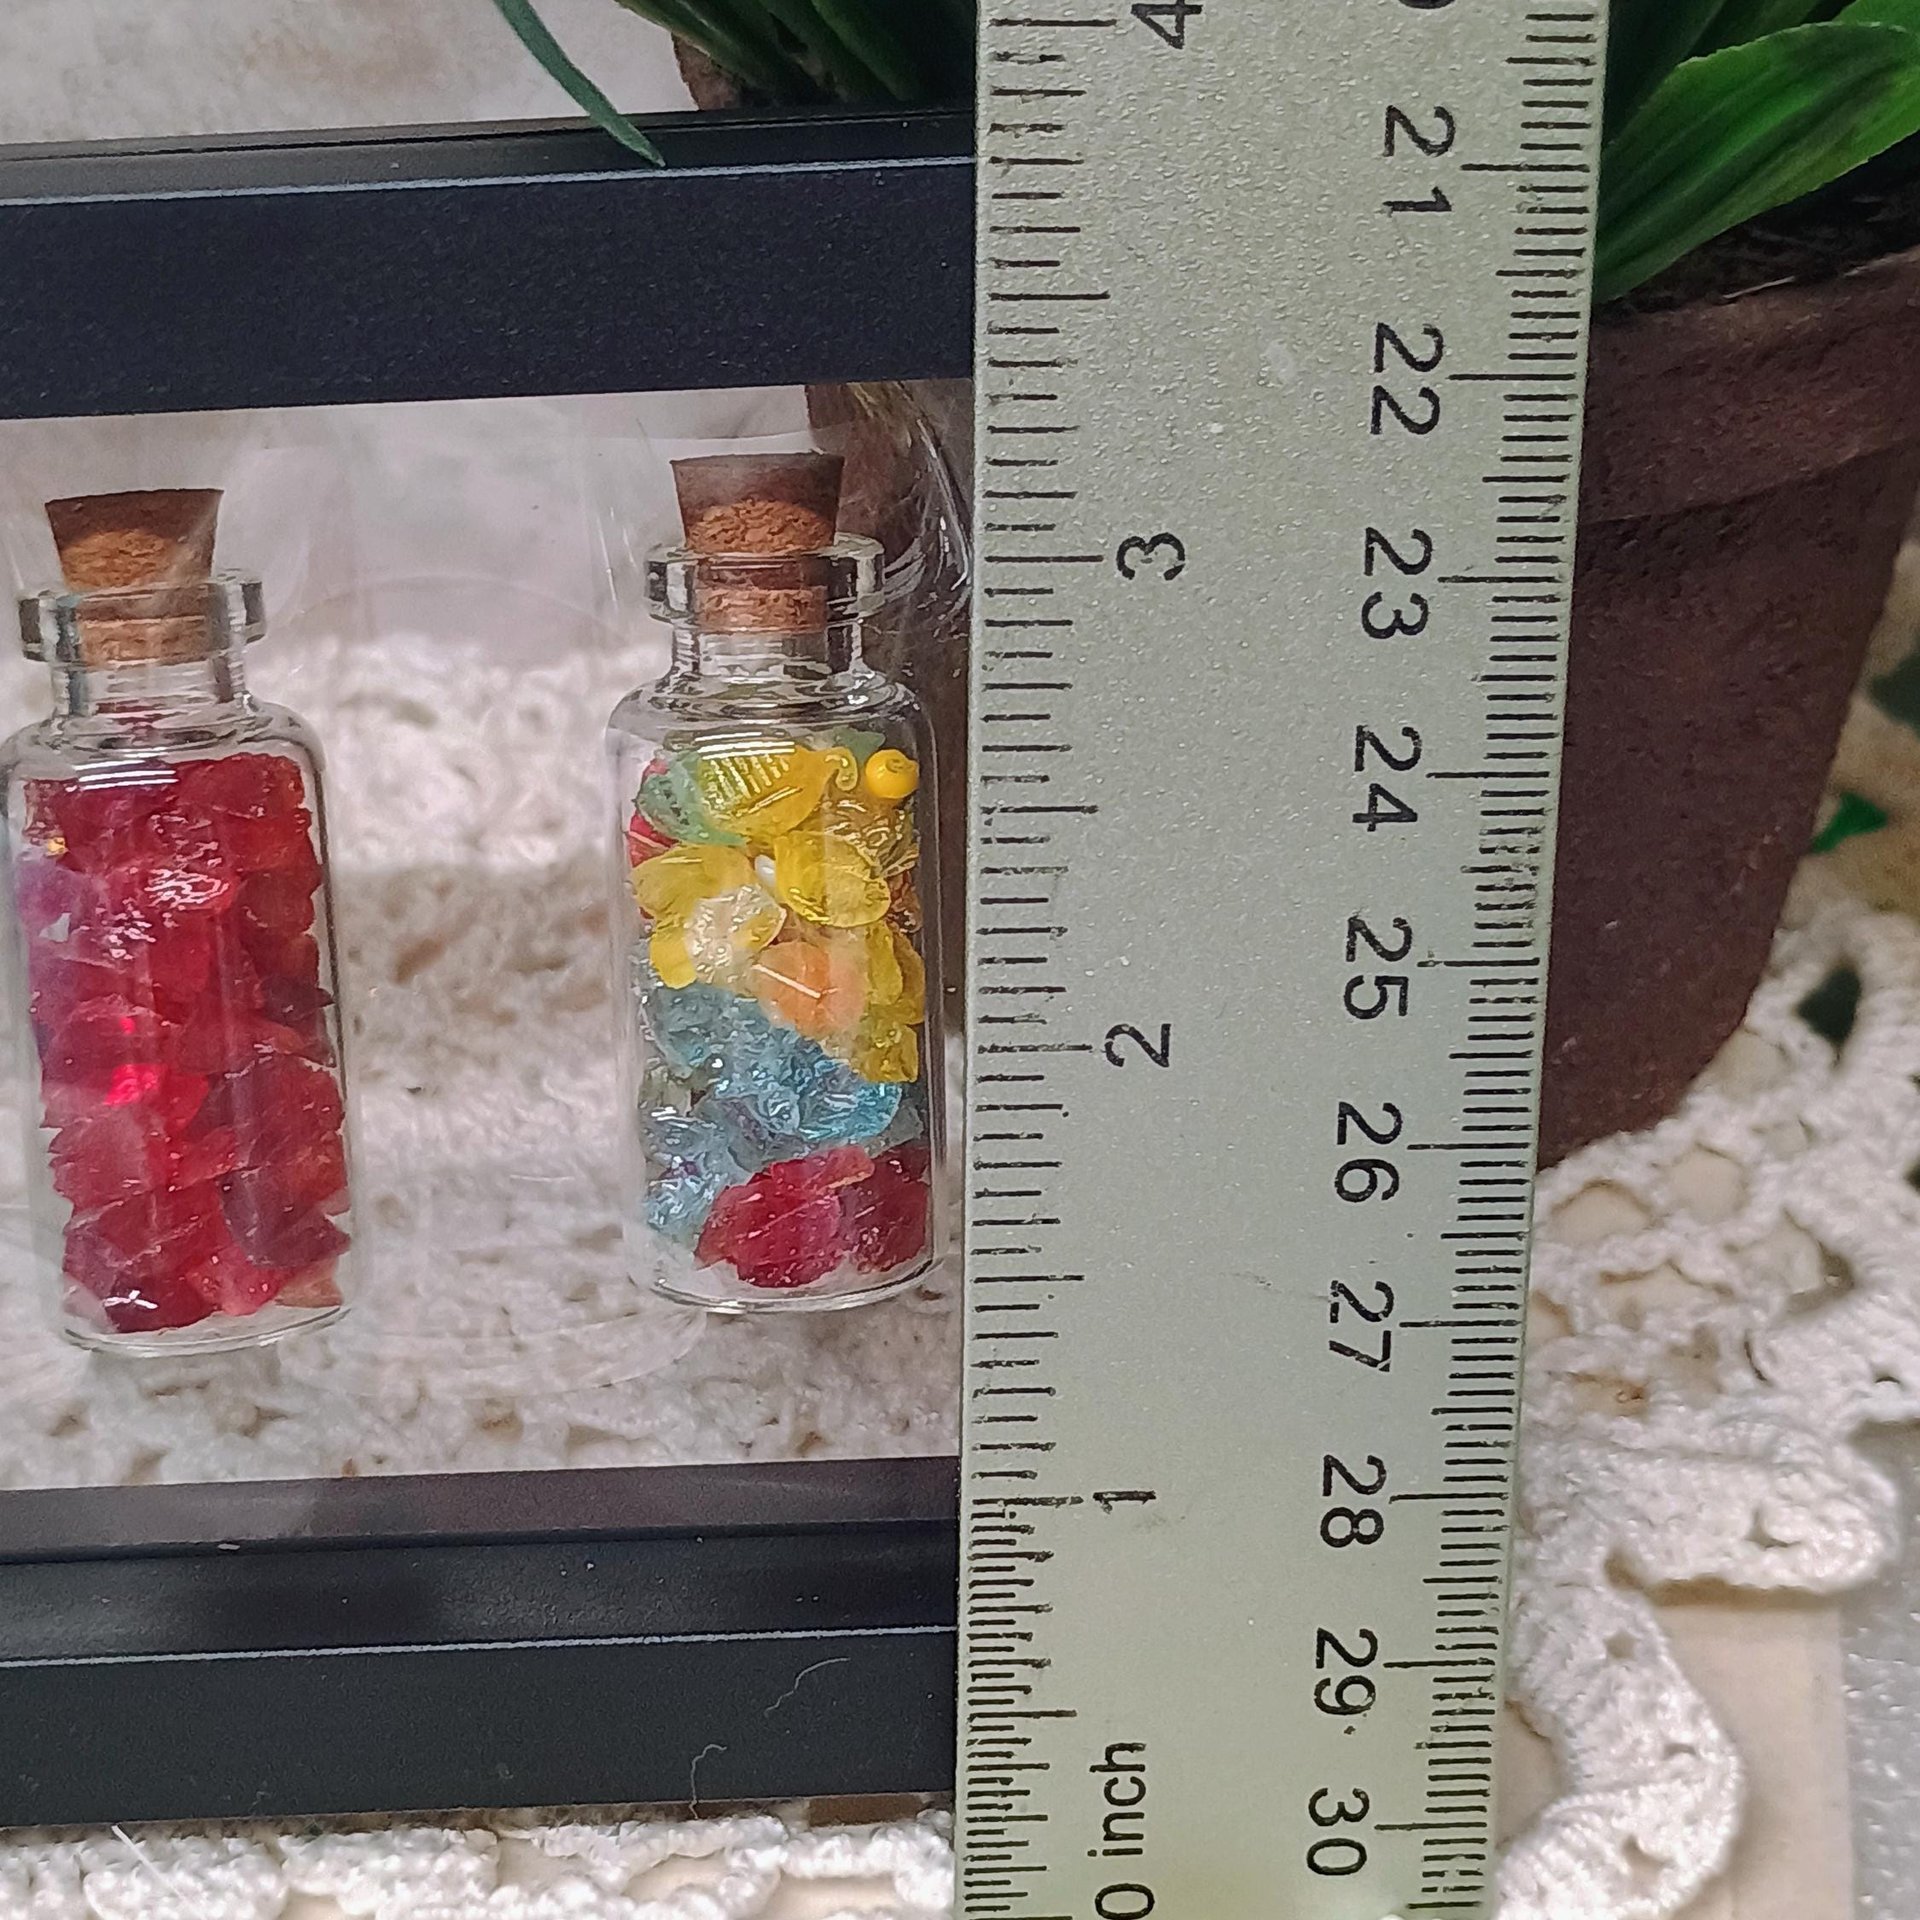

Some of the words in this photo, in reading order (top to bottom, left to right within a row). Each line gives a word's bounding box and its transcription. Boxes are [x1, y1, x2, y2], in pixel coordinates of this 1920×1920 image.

[1131, 0, 1203, 49] 4
[1382, 105, 1456, 217] 21
[1370, 322, 1445, 435] 22
[1116, 532, 1185, 580] 3
[1362, 527, 1434, 639] 23
[1352, 725, 1422, 832] 24
[1343, 915, 1413, 1019] 25
[1106, 1022, 1171, 1067] 2
[1334, 1102, 1403, 1203] 26
[1329, 1280, 1394, 1372] 27
[1093, 1490, 1156, 1510] 1
[1320, 1455, 1386, 1548] 28
[1314, 1628, 1378, 1716] 29
[1088, 1743, 1146, 1856] inch
[1307, 1788, 1369, 1876] 30
[1095, 1883, 1155, 1920] 0
